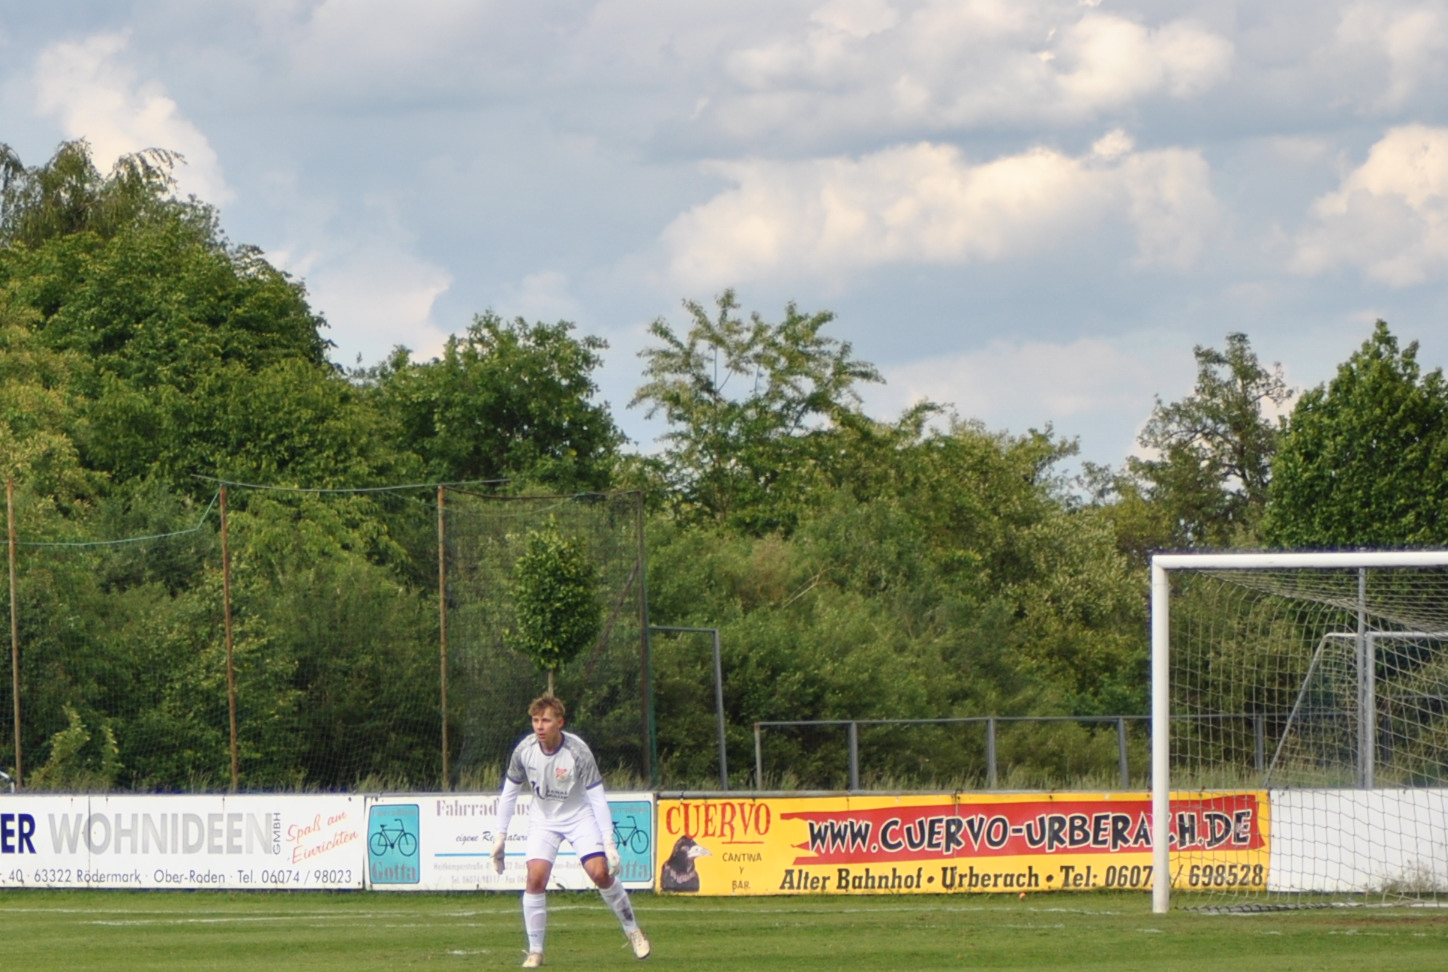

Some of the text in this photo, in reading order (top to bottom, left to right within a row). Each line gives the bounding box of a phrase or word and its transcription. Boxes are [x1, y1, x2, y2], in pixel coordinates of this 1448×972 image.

[436, 797, 530, 817] Fahrradus
[286, 812, 347, 844] Spaß am
[666, 802, 771, 841] CUERVO
[807, 809, 1252, 855] WWW.CUERVO-URBERAH.DE
[48, 812, 273, 855] WOHNIDEEN
[272, 812, 282, 855] GMBH
[292, 830, 358, 865] Einrichten
[722, 852, 762, 862] CANTINA
[8, 868, 24, 882] 40
[34, 869, 72, 883] 63322
[76, 869, 140, 883] Rödermark
[153, 869, 225, 883] Ober-Roden
[237, 870, 256, 883] Tel.
[261, 870, 300, 883] 06074
[314, 869, 352, 884] 98023
[372, 862, 417, 881] Gotta
[616, 861, 649, 879] otta
[739, 866, 745, 874] Y
[779, 868, 831, 890] Alter
[836, 867, 923, 890] Bahnhof
[941, 865, 1040, 889] Urberach
[1060, 865, 1098, 888] Tel:
[1105, 865, 1164, 888] 0607
[1188, 864, 1264, 888] 698528
